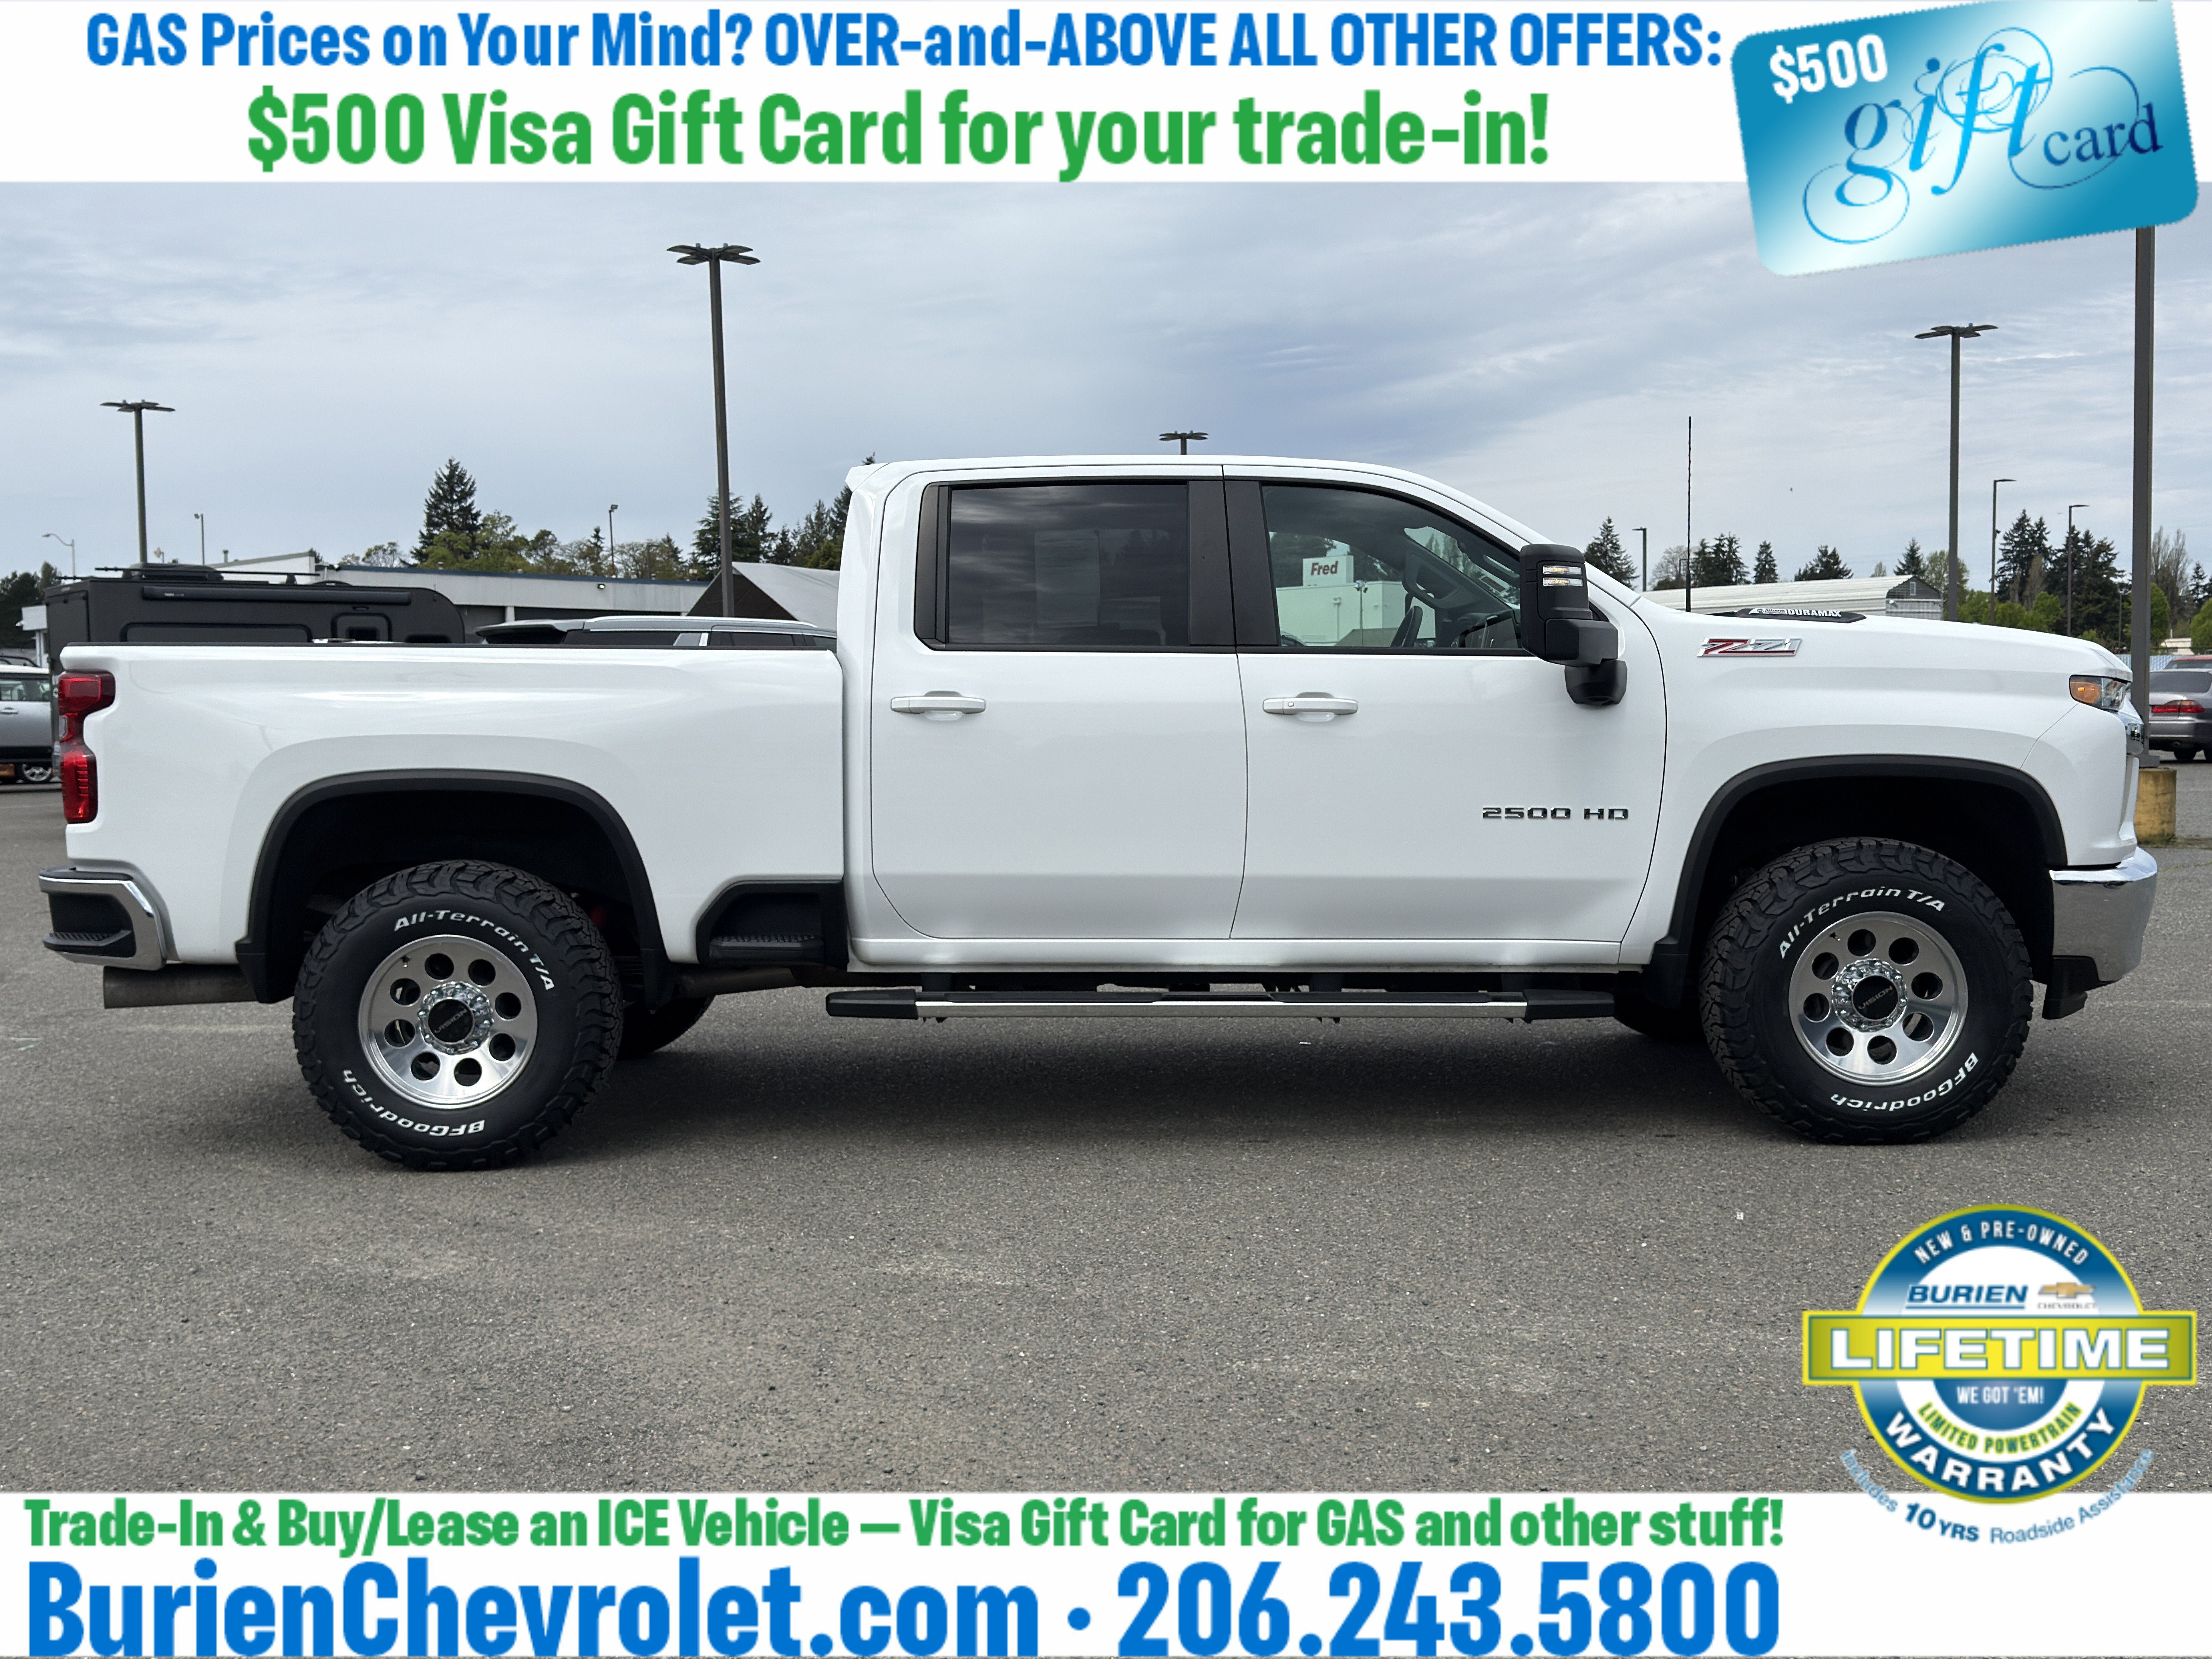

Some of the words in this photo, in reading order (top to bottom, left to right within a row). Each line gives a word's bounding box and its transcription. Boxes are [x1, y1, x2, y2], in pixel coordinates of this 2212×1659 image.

[1311, 561, 1338, 576] Fred
[1788, 609, 1841, 617] DURAMAX
[1697, 637, 1802, 657] Z71
[1482, 807, 1571, 819] 2500
[1584, 808, 1629, 819] HD
[1779, 886, 1901, 959] All-Terrain
[1907, 890, 1946, 912] T/A
[394, 910, 529, 952] All-Terrain
[530, 953, 555, 990] T/A
[1831, 1052, 1979, 1112] BFGoodrich
[343, 1070, 485, 1137] BFGoodrich
